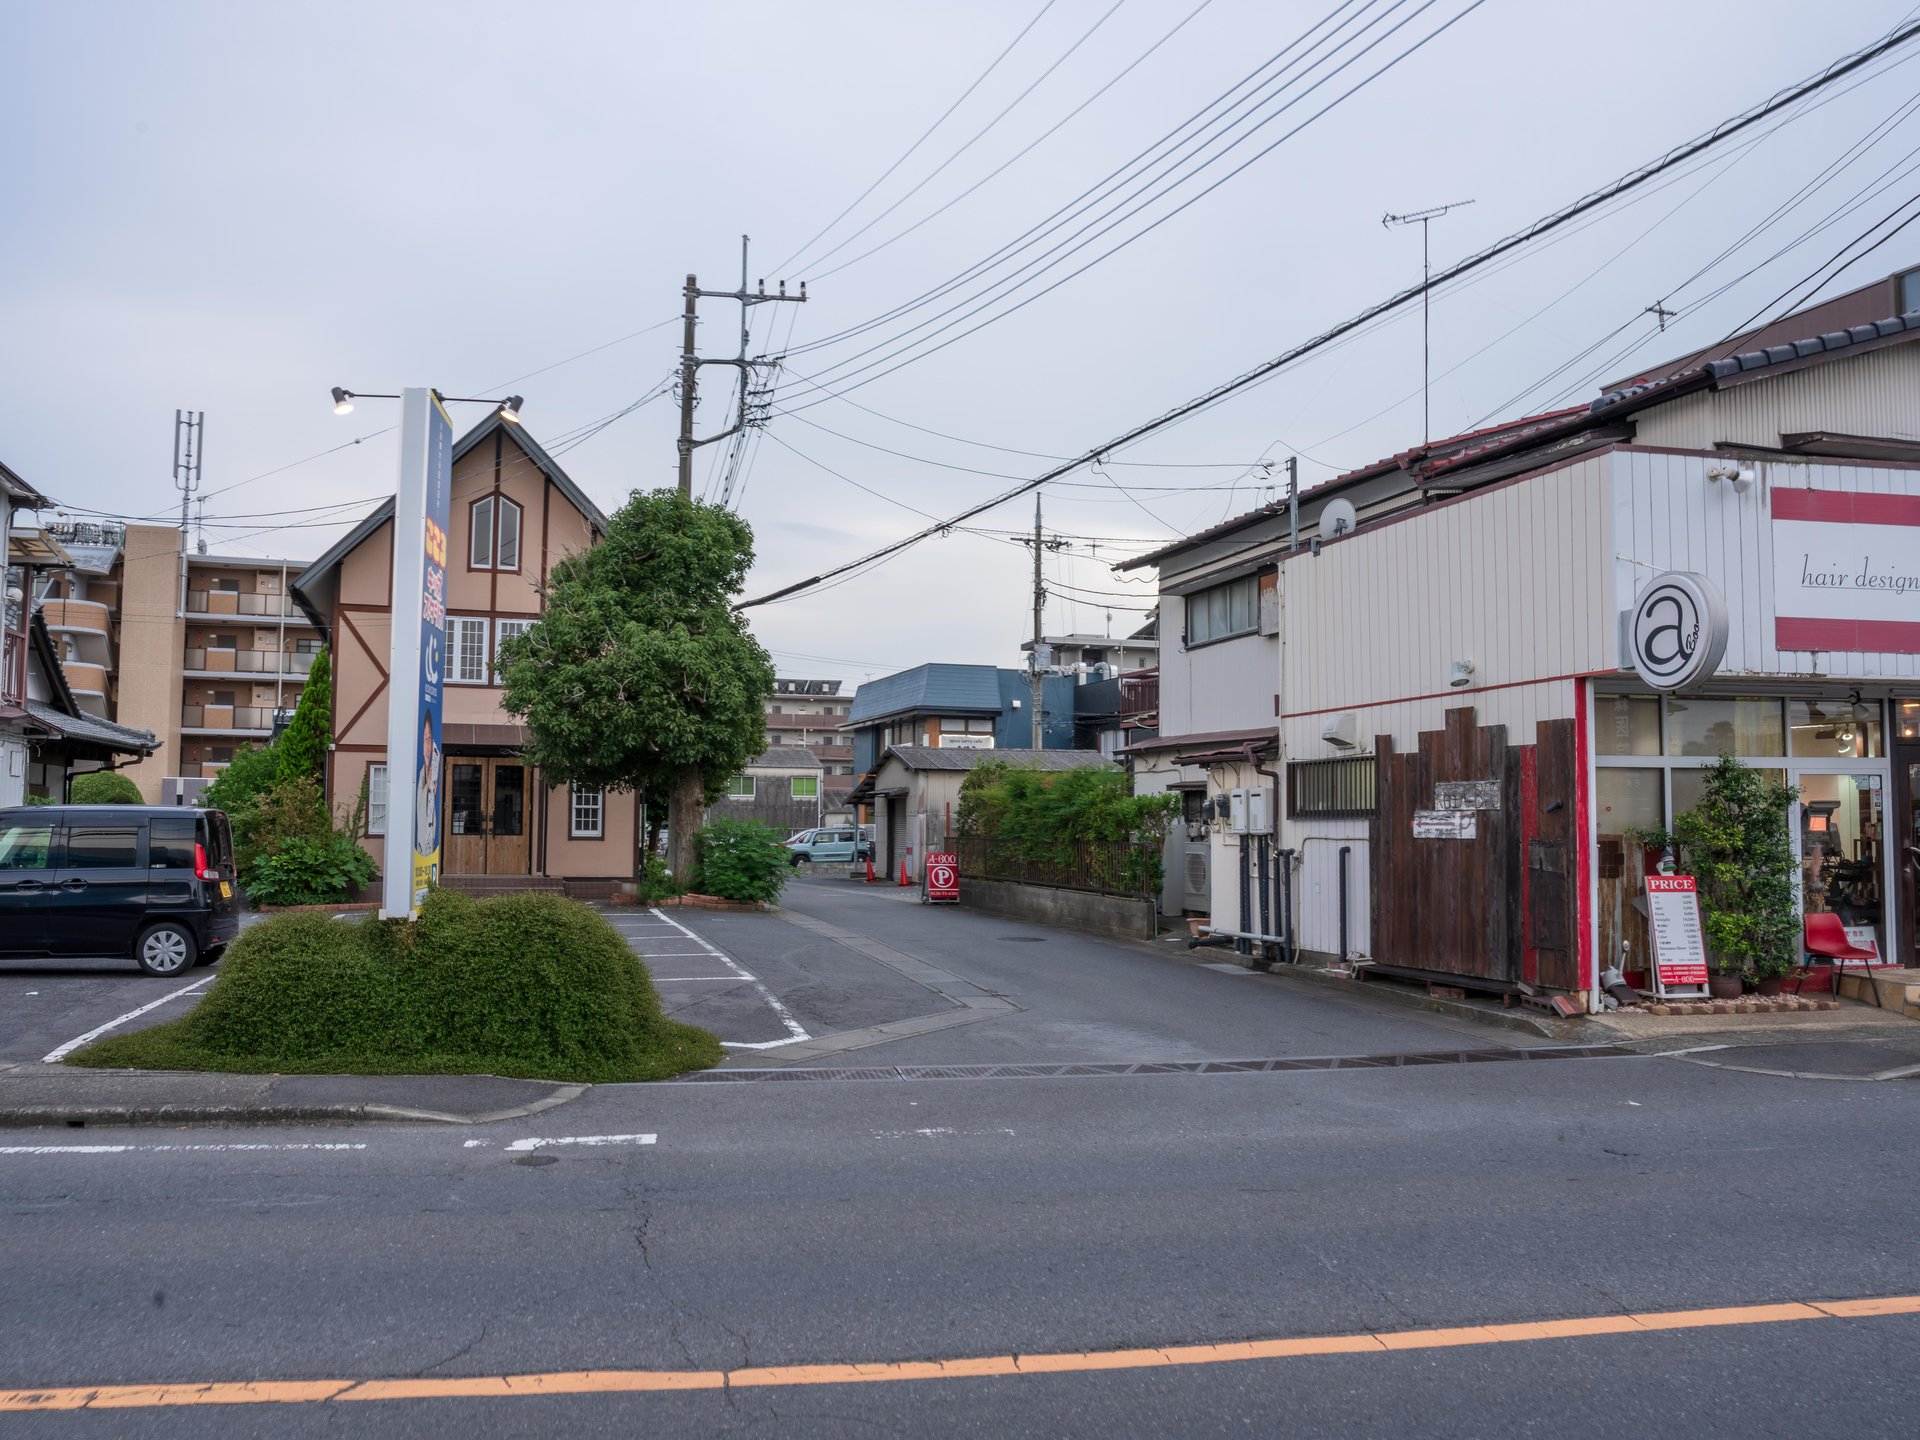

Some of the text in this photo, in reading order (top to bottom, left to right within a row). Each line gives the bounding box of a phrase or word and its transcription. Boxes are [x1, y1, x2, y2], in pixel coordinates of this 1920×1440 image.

[1801, 553, 1920, 595] hair design
[937, 869, 950, 885] P
[1651, 879, 1693, 890] PRICE
